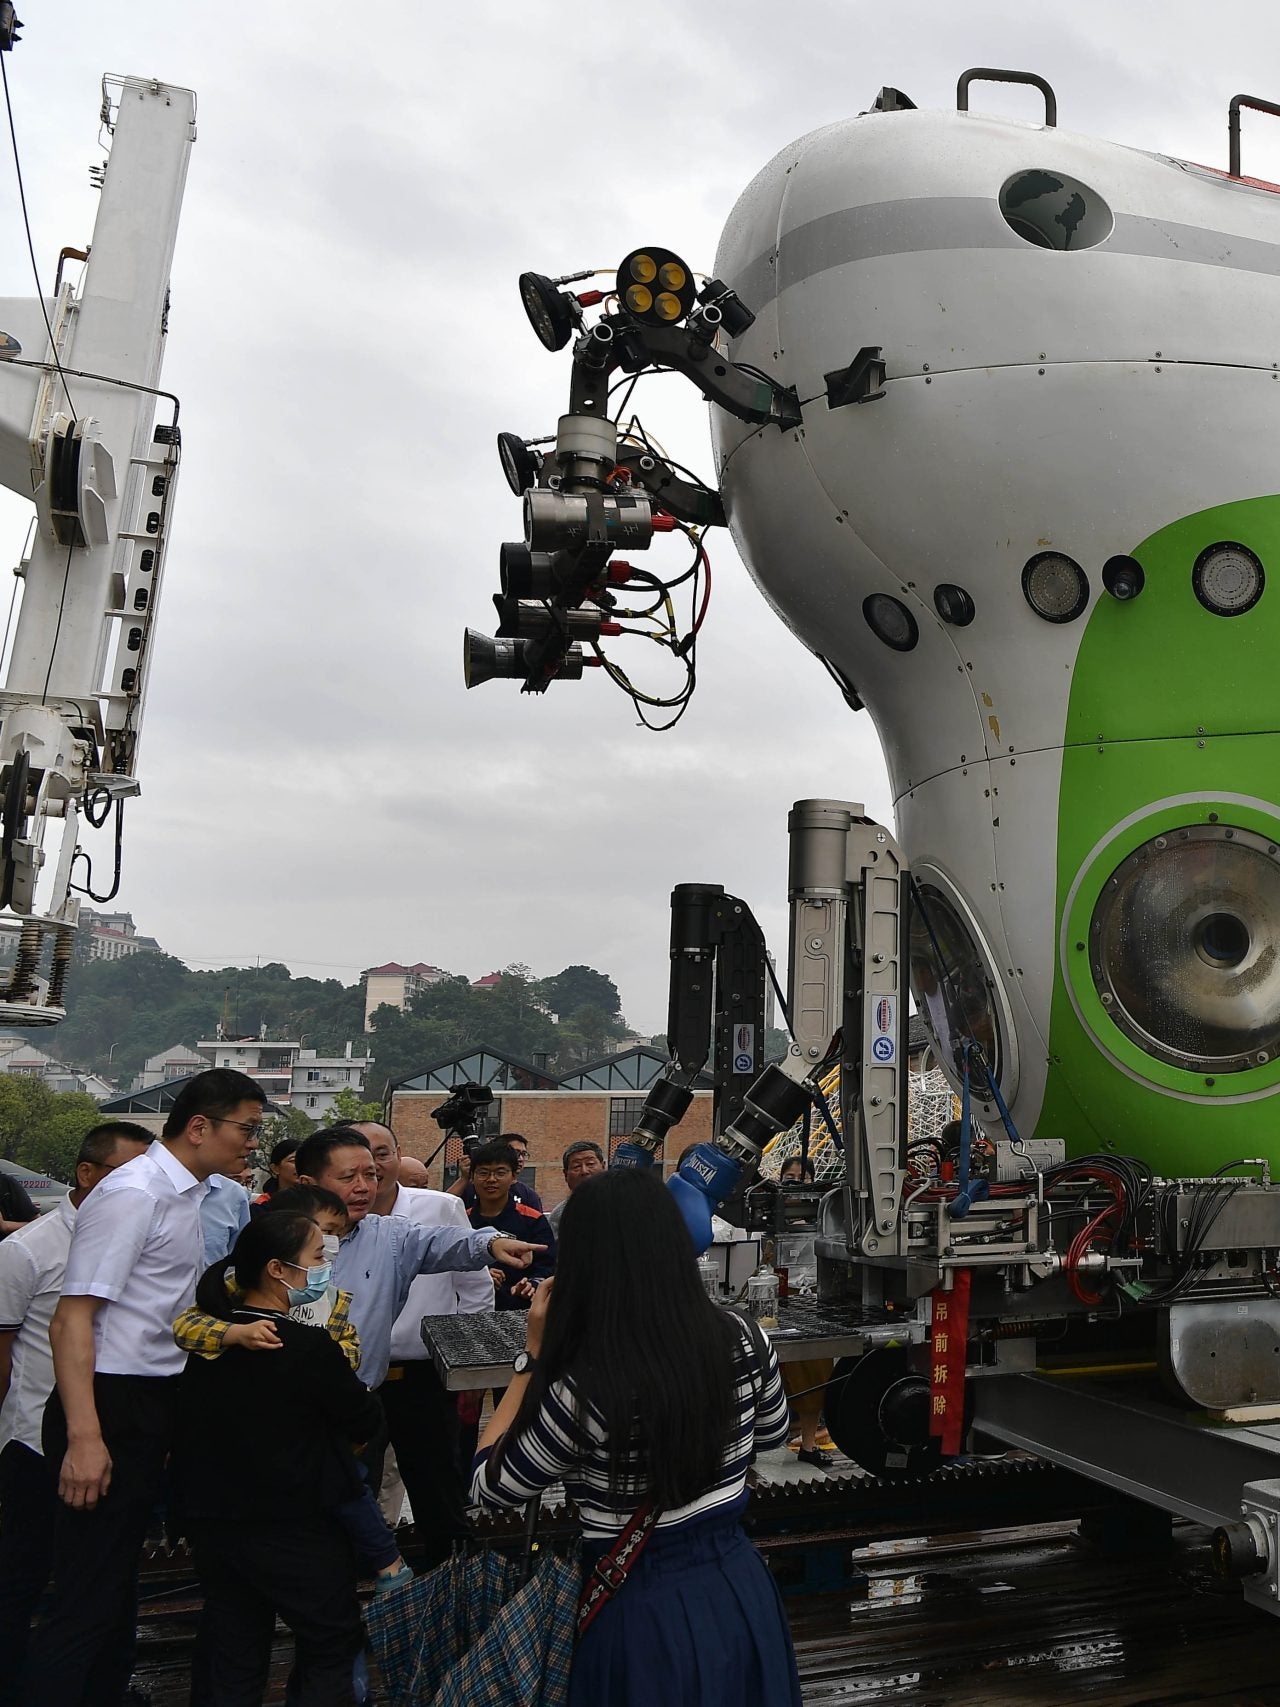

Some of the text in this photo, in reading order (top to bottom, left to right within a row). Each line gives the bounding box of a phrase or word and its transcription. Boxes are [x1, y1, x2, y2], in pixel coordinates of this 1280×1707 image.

[293, 1306, 315, 1320] AND
[933, 1302, 949, 1416] 吊前拆除
